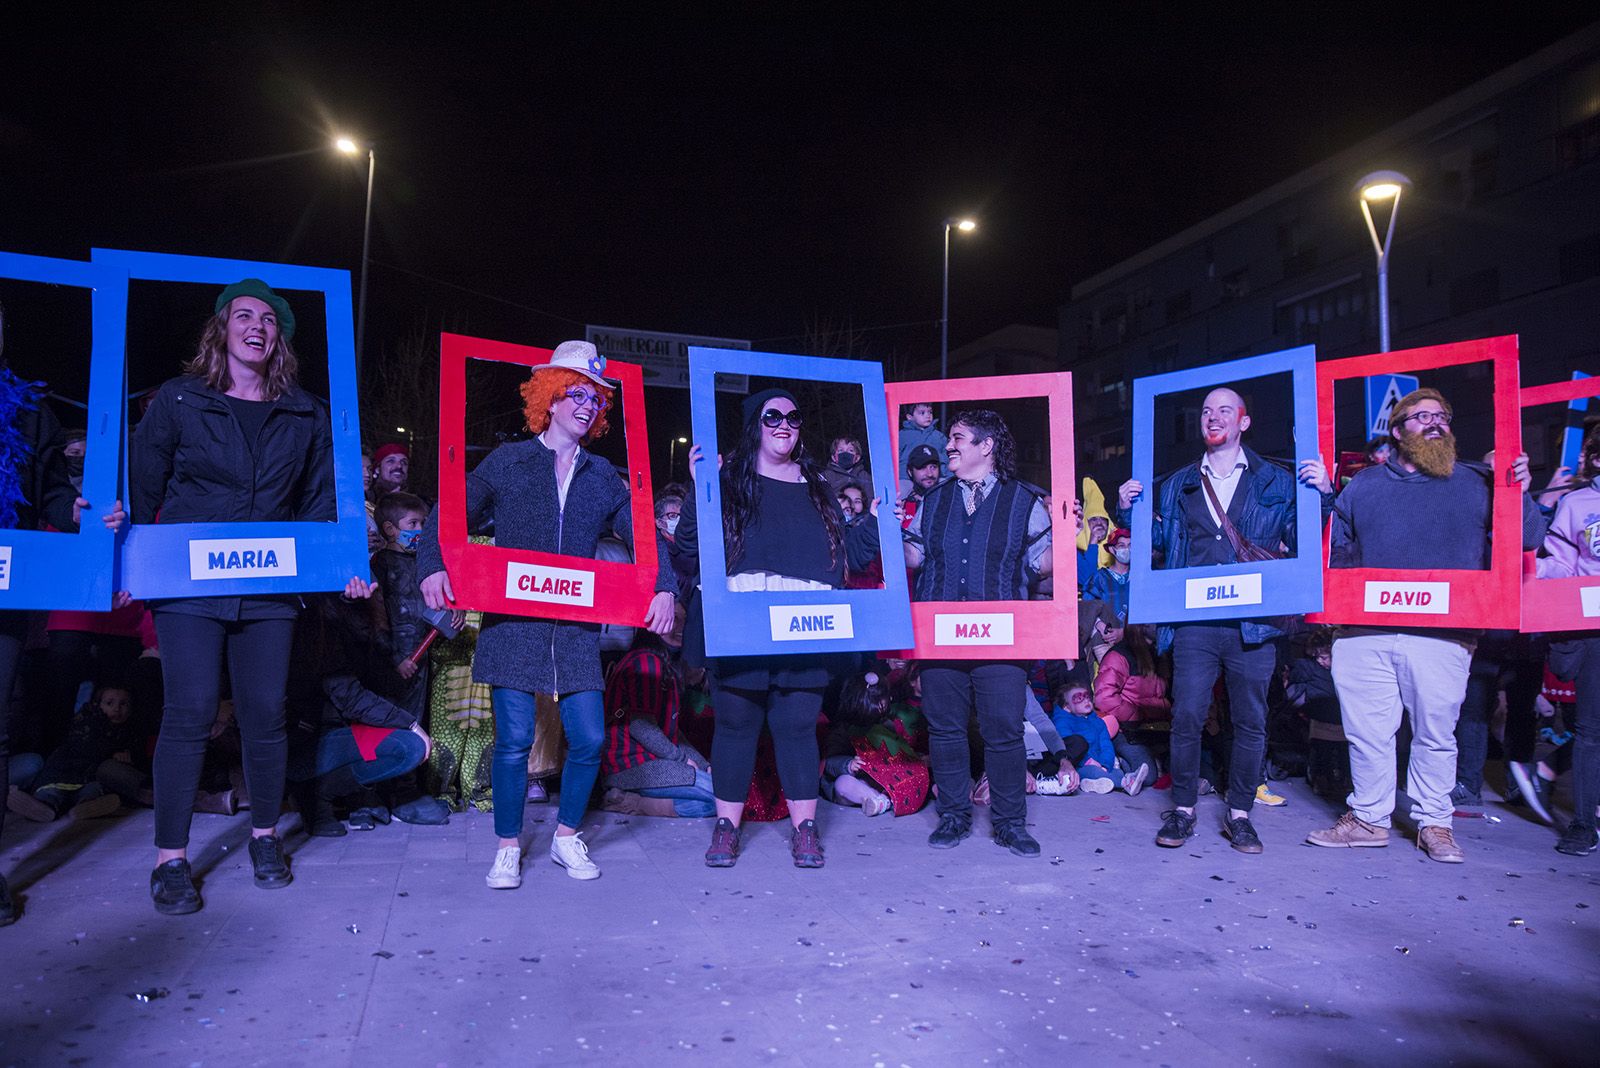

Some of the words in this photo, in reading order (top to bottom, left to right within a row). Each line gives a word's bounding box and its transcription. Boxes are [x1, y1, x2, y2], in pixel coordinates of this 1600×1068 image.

[208, 549, 279, 570] MARIA
[517, 574, 583, 597] CLAIRE
[1206, 584, 1240, 601] BILL
[1379, 590, 1432, 606] DAVID
[789, 615, 835, 632] ANNE
[955, 623, 992, 638] MAX
